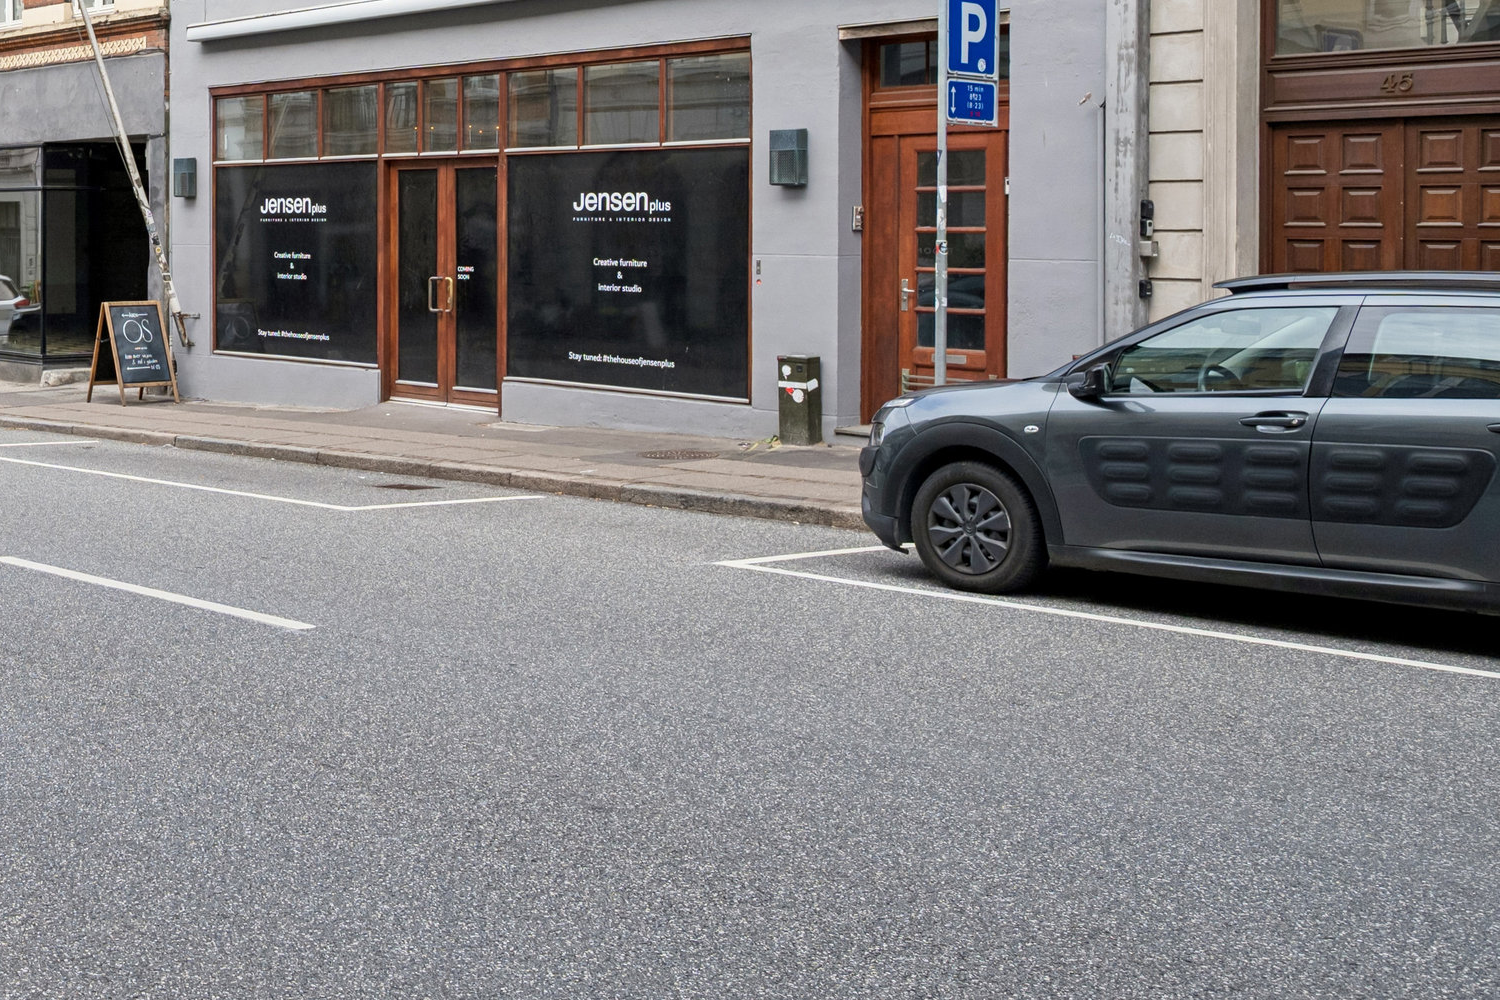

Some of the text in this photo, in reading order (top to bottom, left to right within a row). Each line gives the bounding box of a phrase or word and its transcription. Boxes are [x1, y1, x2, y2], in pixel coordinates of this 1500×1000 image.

[960, 1, 988, 65] P
[974, 85, 984, 93] min
[274, 251, 311, 260] Creative furniture
[290, 262, 295, 270] &
[593, 257, 648, 268] Creative furniture
[293, 273, 308, 281] studio
[616, 270, 623, 280] &
[622, 284, 643, 293] studio
[122, 318, 153, 344] OS
[258, 328, 267, 338] Stay
[568, 351, 676, 370] Stay tuned: #thehouseofjensenplus
